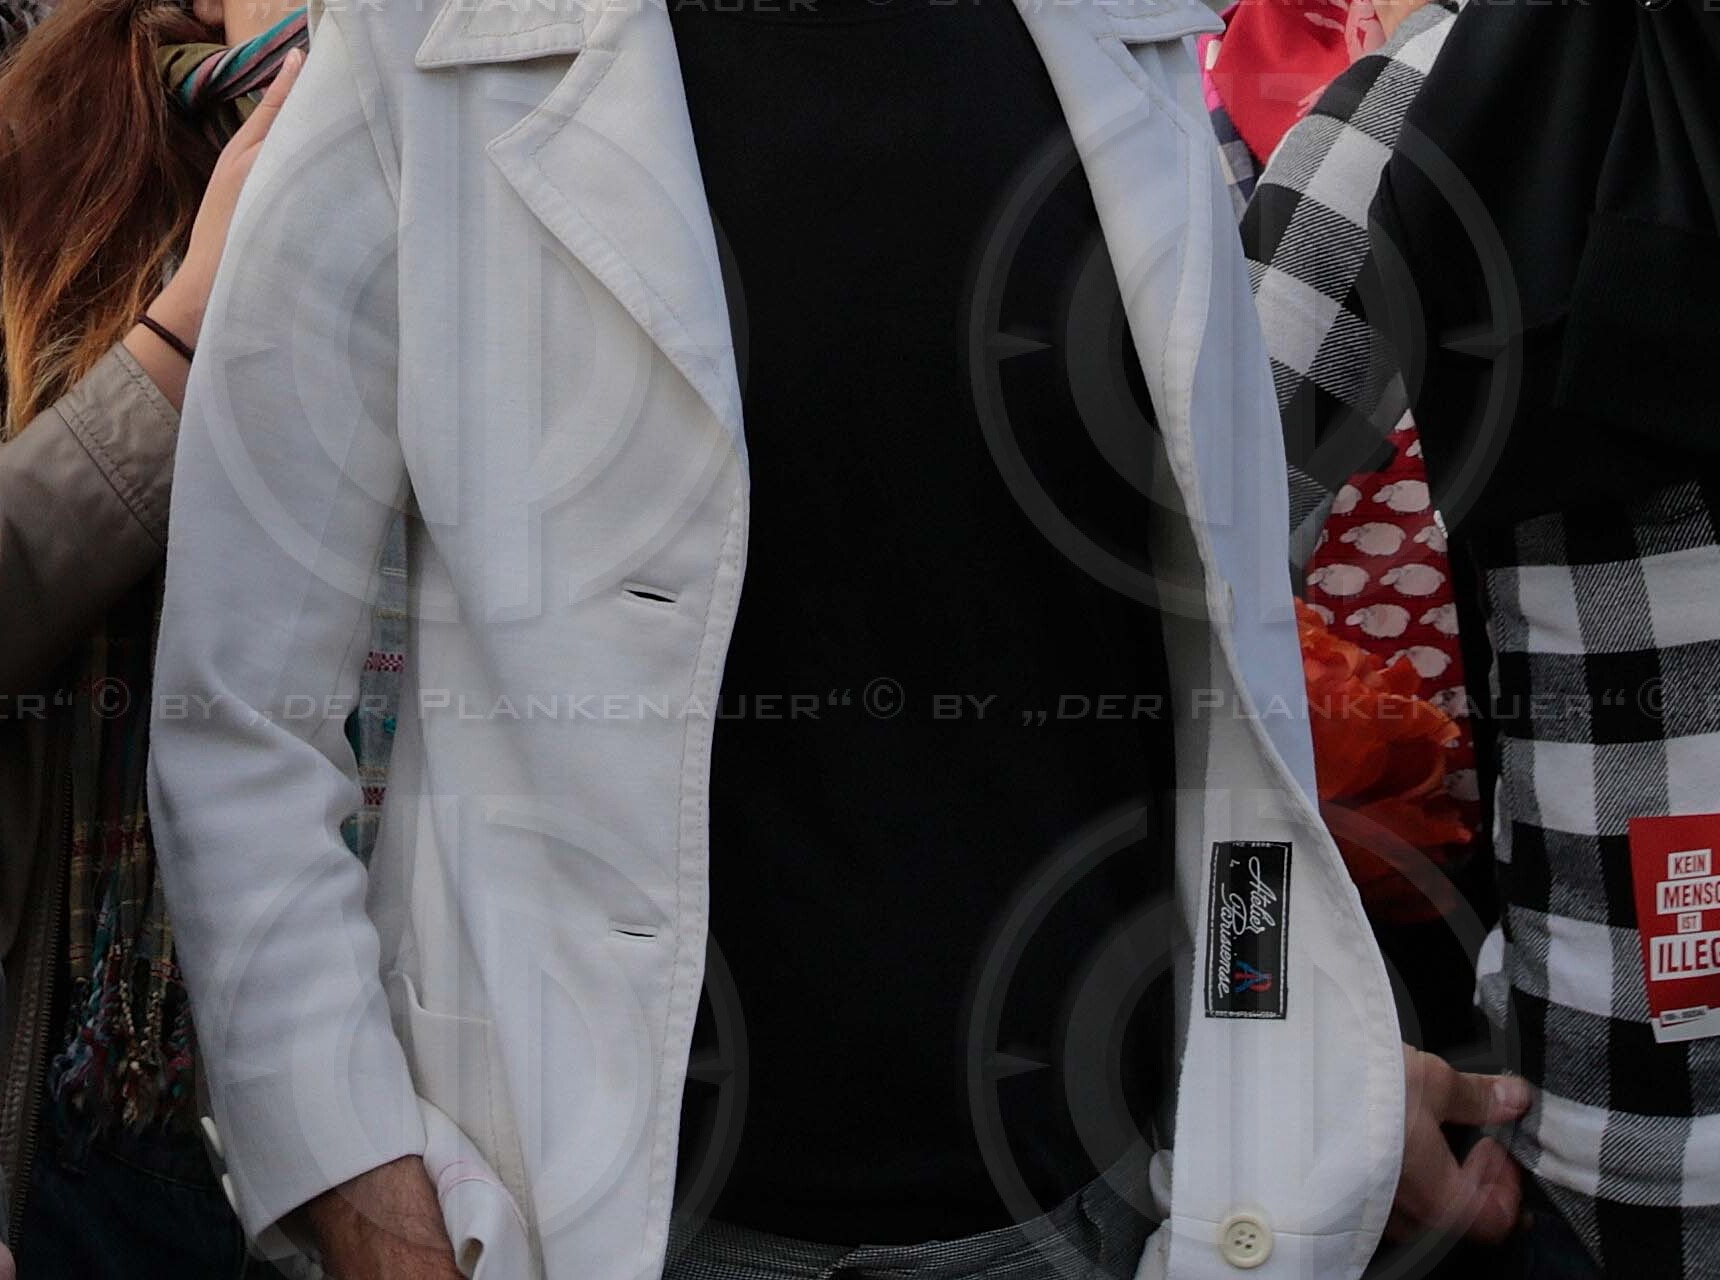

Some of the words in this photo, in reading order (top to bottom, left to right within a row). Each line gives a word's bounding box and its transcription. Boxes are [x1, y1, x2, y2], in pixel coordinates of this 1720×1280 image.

[1673, 854, 1707, 876] KEIN
[1244, 856, 1278, 935] Atelier
[1680, 915, 1698, 929] IST
